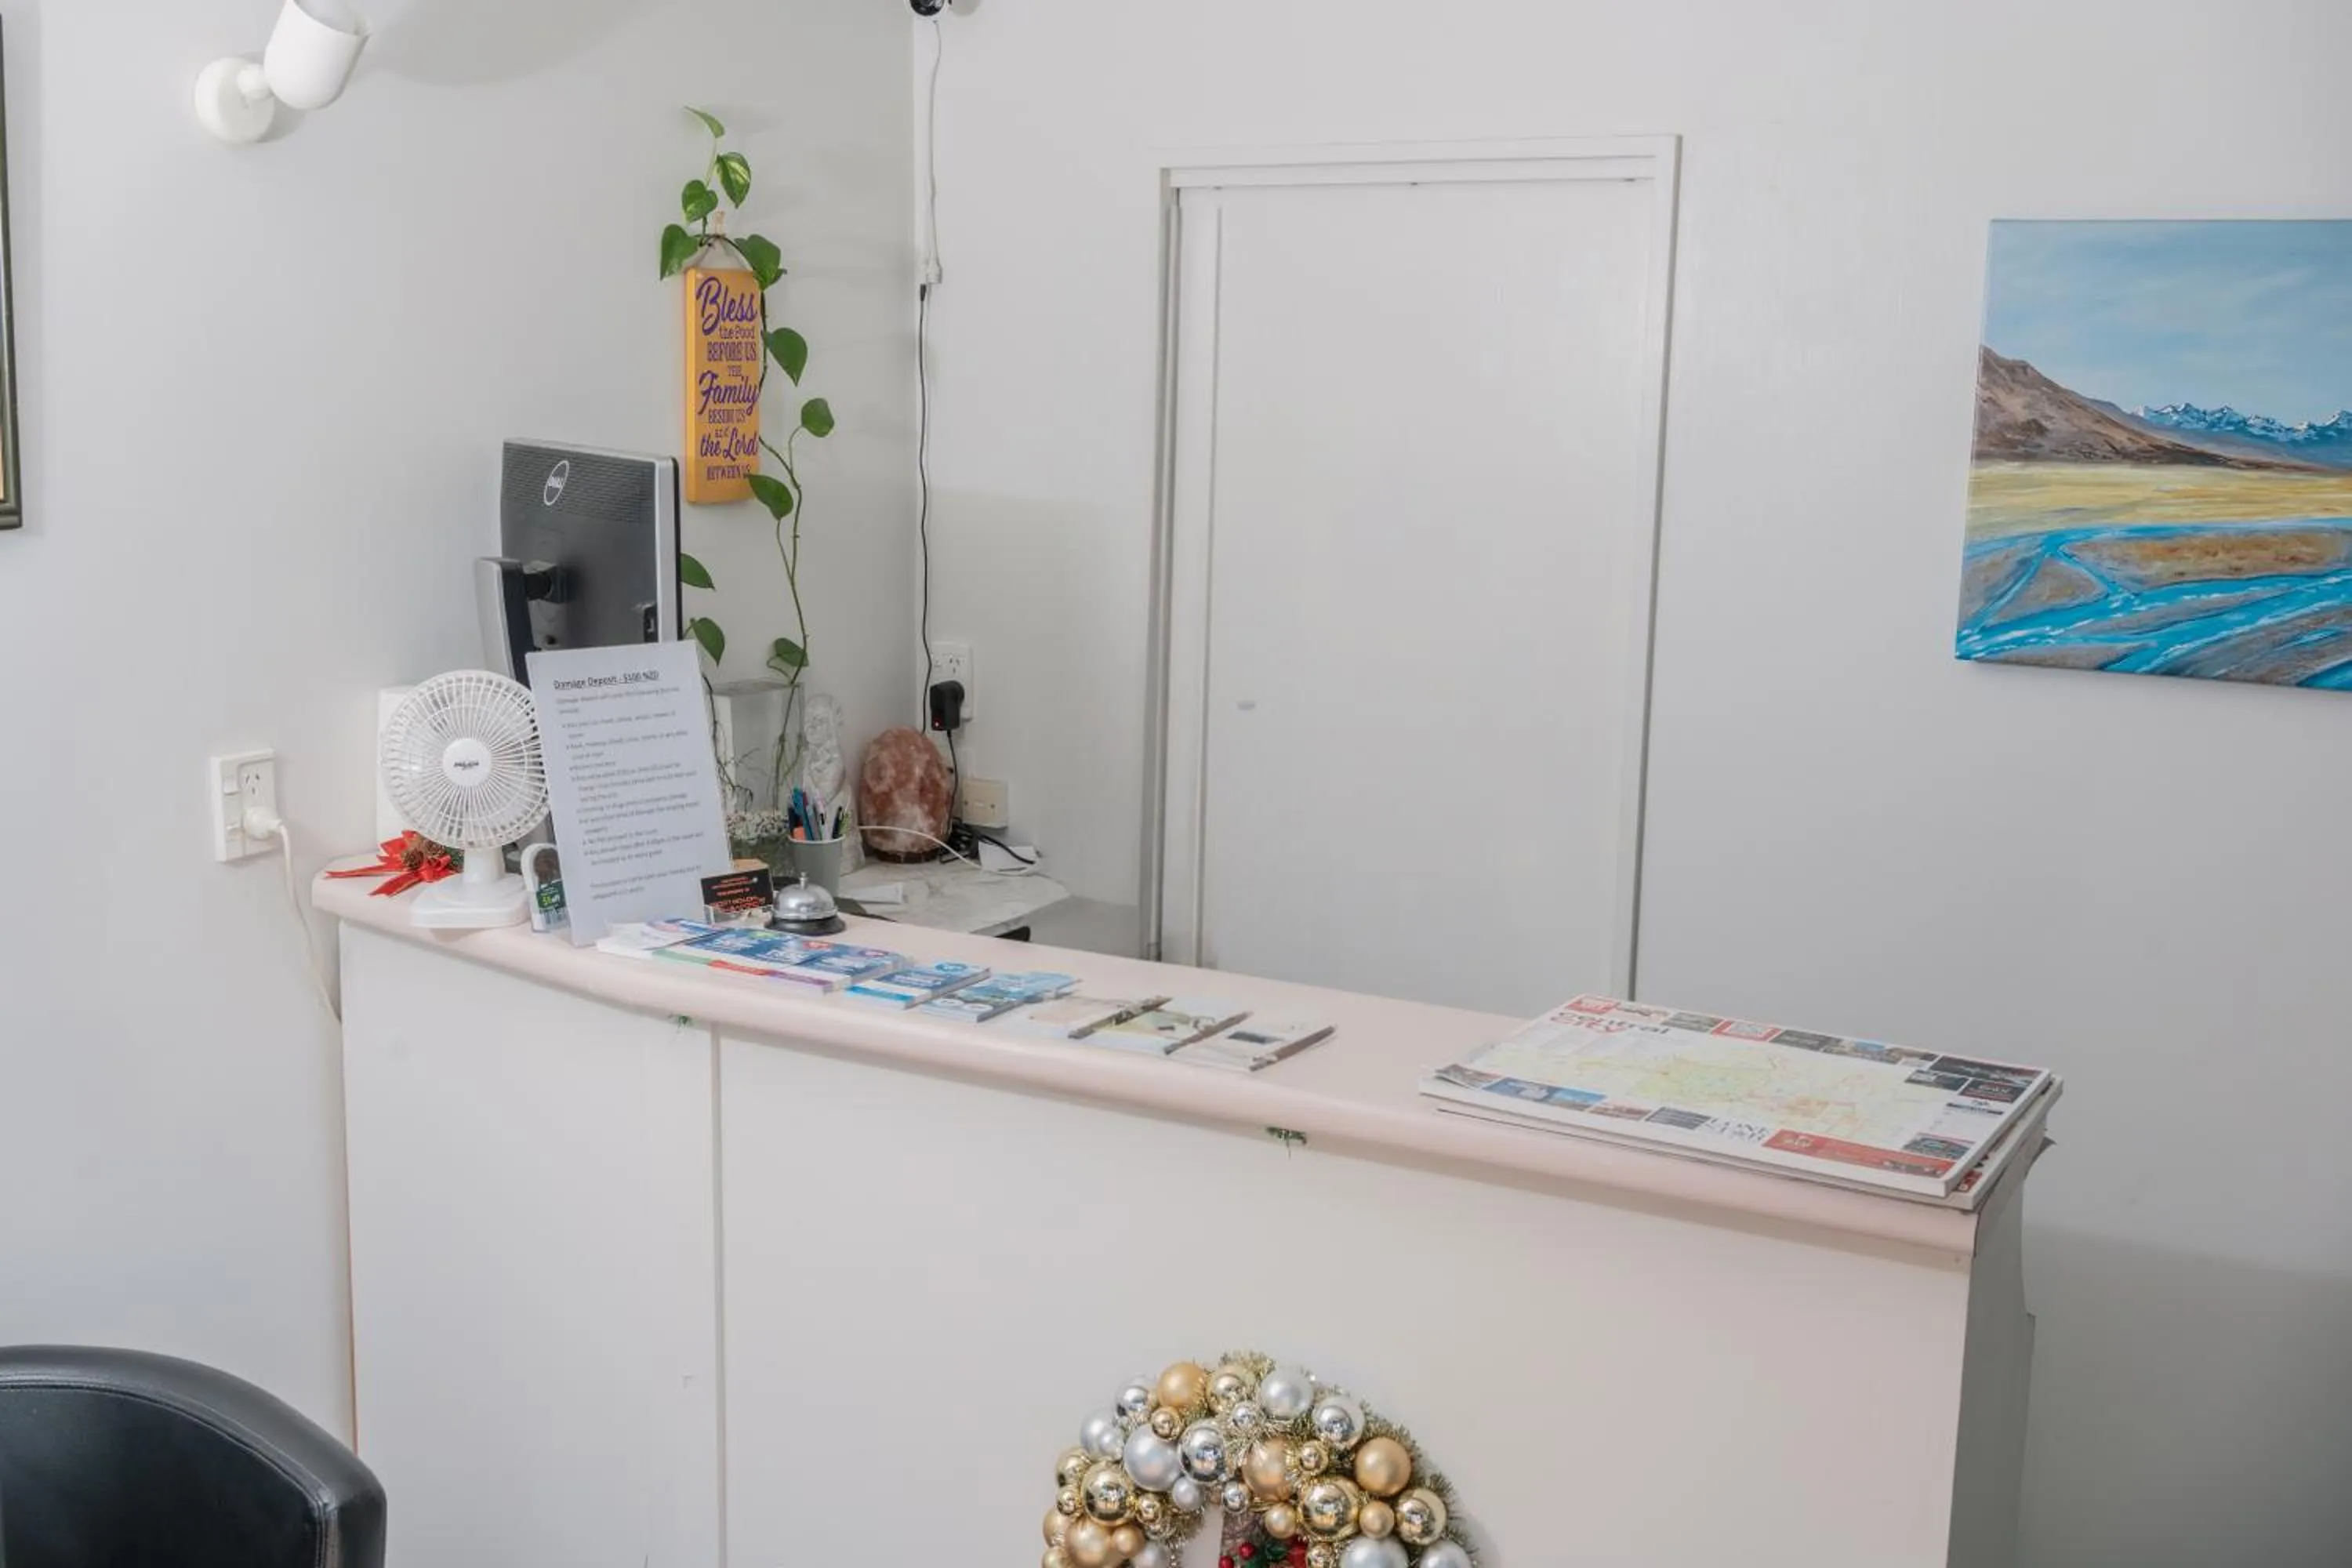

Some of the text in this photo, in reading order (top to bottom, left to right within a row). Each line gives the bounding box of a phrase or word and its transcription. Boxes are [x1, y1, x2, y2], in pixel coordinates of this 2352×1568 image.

[696, 276, 758, 336] Bless
[743, 340, 757, 361] US
[698, 370, 759, 416] Family
[701, 426, 758, 462] the Lord
[553, 679, 585, 690] Damage
[587, 677, 618, 688] Deposit
